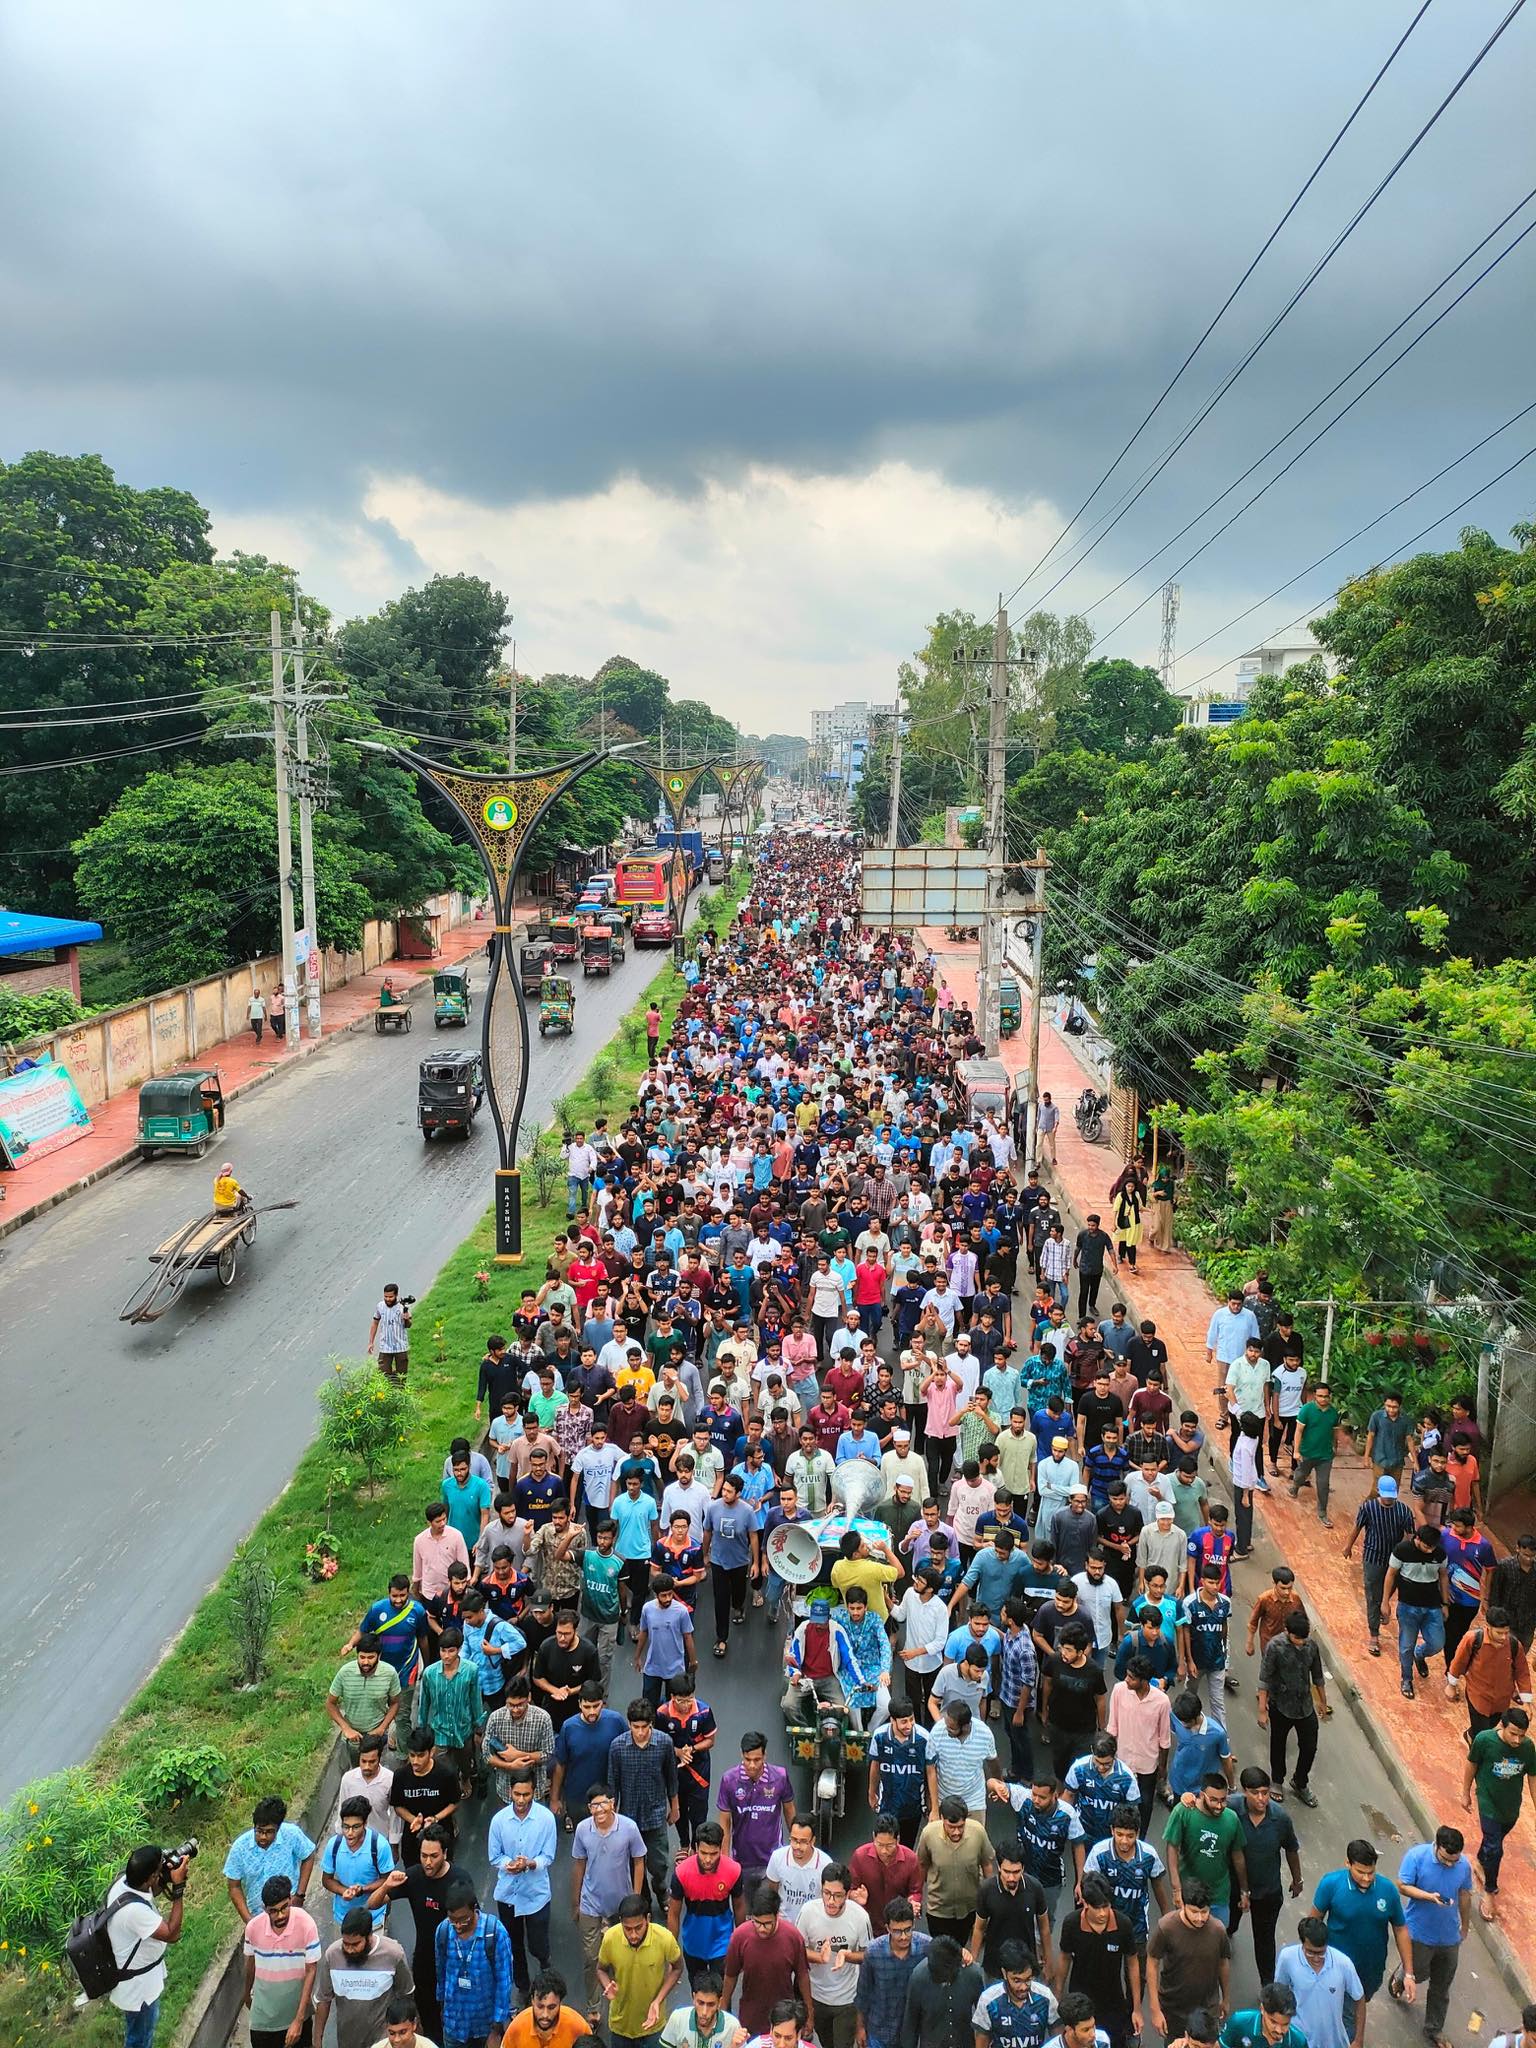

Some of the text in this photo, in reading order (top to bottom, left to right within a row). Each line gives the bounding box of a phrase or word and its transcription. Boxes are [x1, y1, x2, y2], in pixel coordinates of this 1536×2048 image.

[710, 1432, 727, 1441] IVIL
[586, 1579, 611, 1593] CIVIL
[884, 1746, 893, 1754] 21
[880, 1762, 921, 1775] CIVIL
[1085, 1779, 1095, 1788] 21
[1023, 1826, 1058, 1850] CIVIL
[1107, 1868, 1118, 1877] 21
[1001, 2016, 1012, 2026] 21
